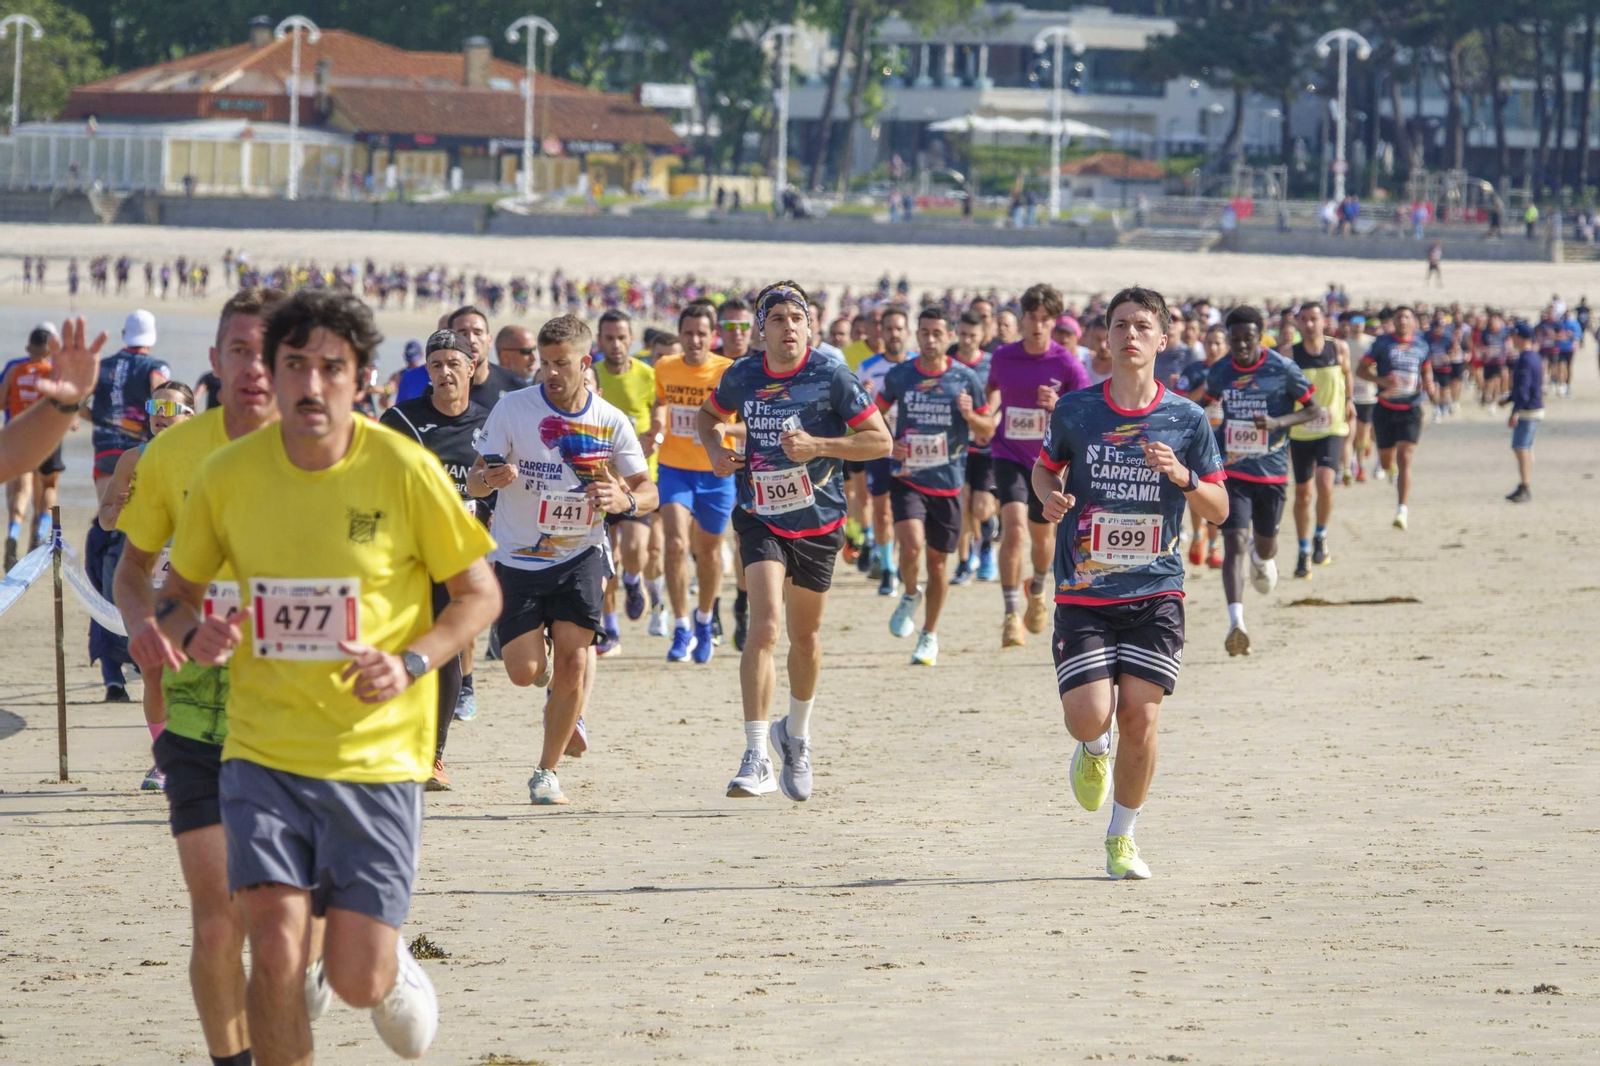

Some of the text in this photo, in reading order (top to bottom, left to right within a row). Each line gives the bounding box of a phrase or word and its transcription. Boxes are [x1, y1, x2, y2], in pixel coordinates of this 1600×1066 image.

[755, 400, 800, 418] FE seguros
[1234, 430, 1258, 442] 690
[915, 444, 939, 455] 614
[1103, 445, 1125, 463] FE
[518, 459, 563, 474] CARREIRA
[1091, 463, 1160, 483] CARREIRA
[766, 482, 798, 499] 504
[1090, 481, 1161, 502] PRAIA DE SAMIL
[552, 505, 582, 520] 441
[1107, 529, 1146, 547] 699
[273, 604, 332, 631] 477
